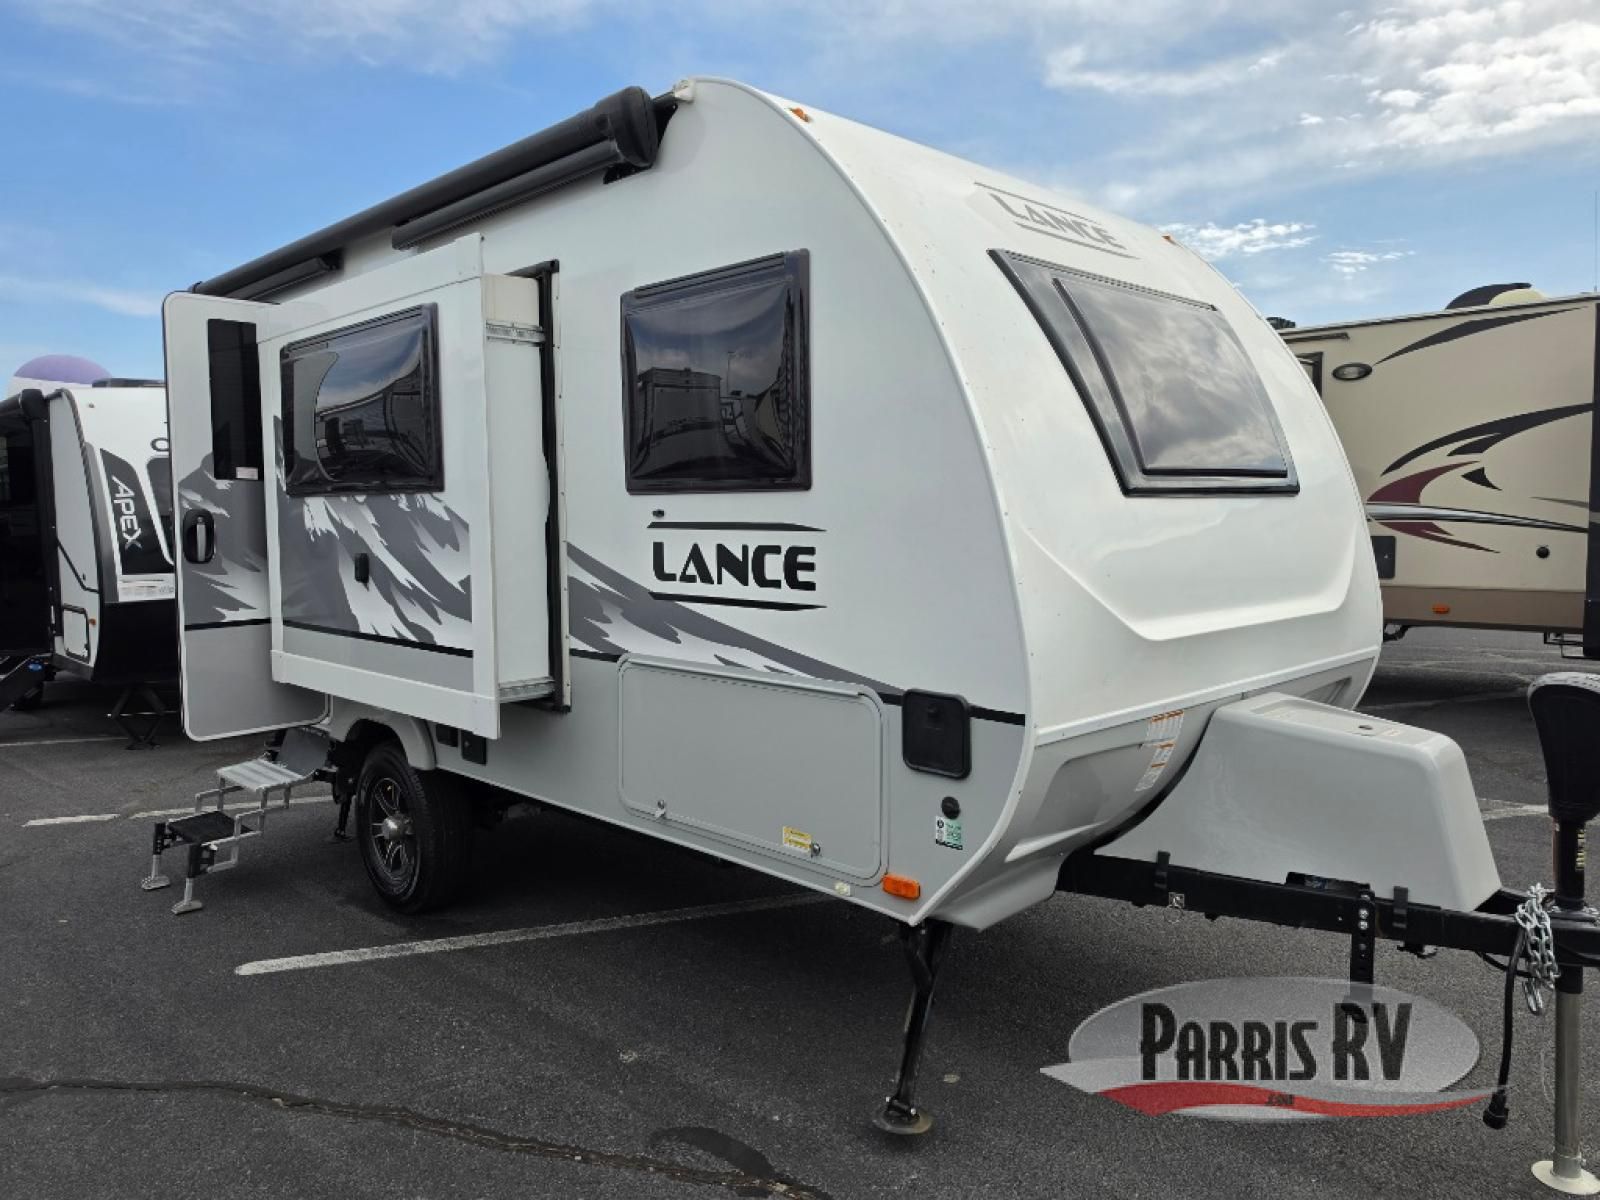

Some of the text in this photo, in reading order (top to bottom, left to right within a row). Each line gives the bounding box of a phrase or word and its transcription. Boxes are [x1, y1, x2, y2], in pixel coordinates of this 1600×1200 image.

[990, 193, 1127, 250] LANCE
[111, 475, 142, 549] APEX
[653, 542, 816, 591] LANCE
